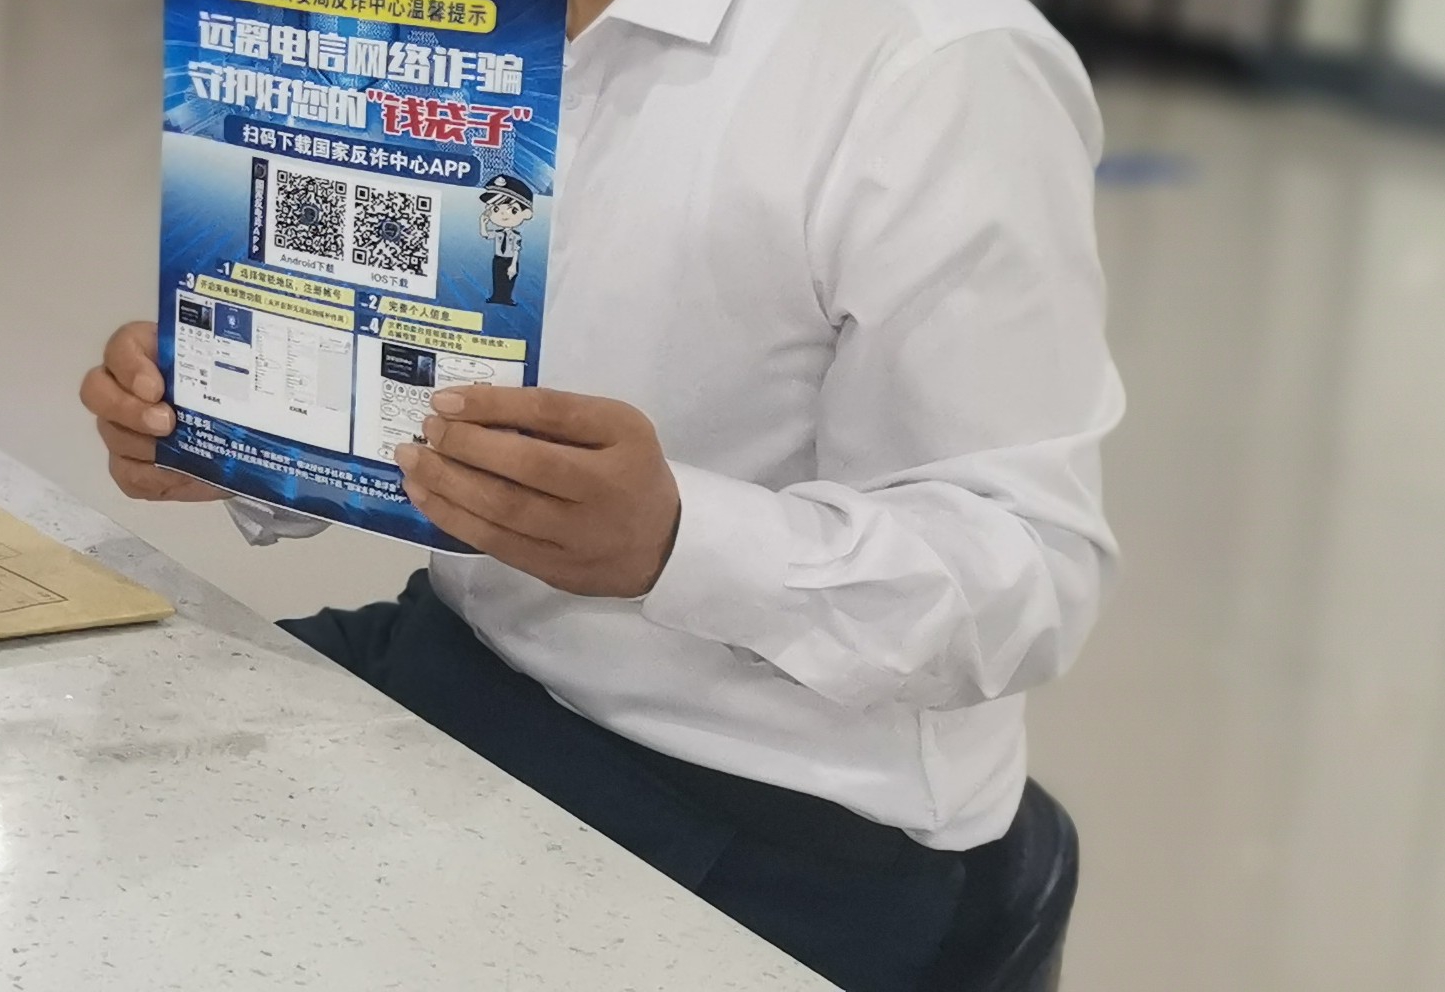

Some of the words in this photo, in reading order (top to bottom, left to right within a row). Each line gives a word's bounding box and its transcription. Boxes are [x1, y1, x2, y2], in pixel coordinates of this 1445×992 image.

[198, 11, 525, 96] 远离电信网络诈骗
[242, 123, 471, 179] 扫码下载国家反诈中心APP
[279, 253, 335, 274] Android下载
